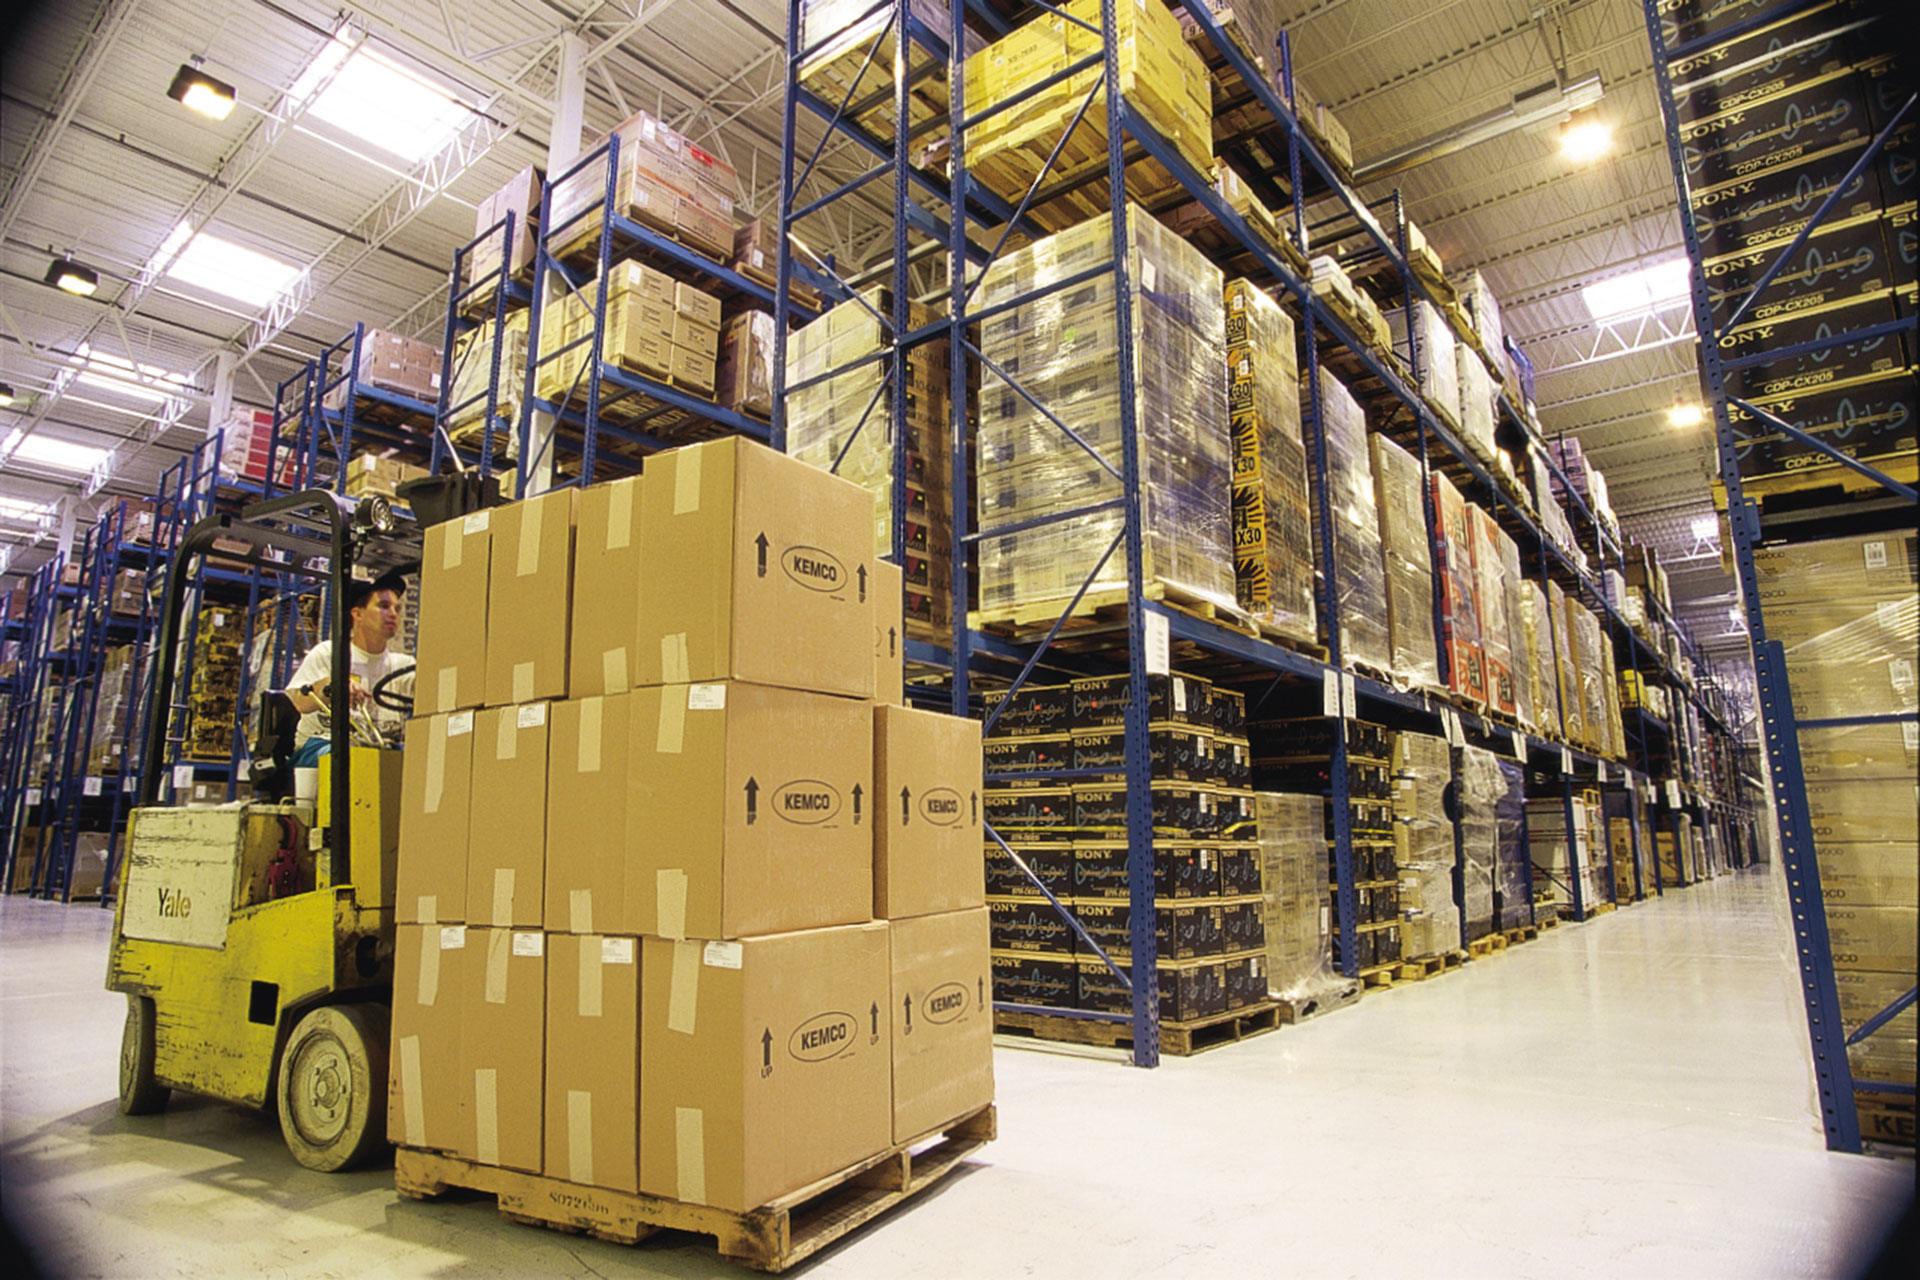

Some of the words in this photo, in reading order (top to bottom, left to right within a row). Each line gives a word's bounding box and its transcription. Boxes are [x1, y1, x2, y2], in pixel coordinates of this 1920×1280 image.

[1669, 48, 1729, 79] SONY
[1719, 80, 1786, 110] CDP-CX205
[1680, 112, 1746, 143] SONY
[1736, 146, 1803, 176] CDP-CX205
[1692, 181, 1756, 211] SONY
[1746, 220, 1809, 246] CDP-CX20
[1755, 294, 1825, 319] CDP-CX205
[1717, 326, 1774, 349] ONY
[1764, 372, 1834, 394] CDP-CX205
[1233, 457, 1256, 475] X30
[1233, 527, 1262, 547] X30
[794, 556, 838, 582] KEMCO
[1073, 680, 1111, 693] SONY
[985, 744, 1018, 755] SONY
[1074, 736, 1111, 748] SONY
[785, 793, 831, 811] KEMCO
[928, 799, 958, 814] KEMCO
[985, 797, 1018, 807] SONY
[1075, 792, 1113, 803] SONY
[1075, 849, 1112, 860] SONY
[158, 887, 191, 918] Yale
[1077, 905, 1114, 917] SONY
[1079, 964, 1115, 976] SONY
[930, 992, 963, 1015] KEMCO
[801, 1022, 847, 1051] KEMCO
[870, 1034, 880, 1046] UP
[761, 1065, 773, 1080] UP
